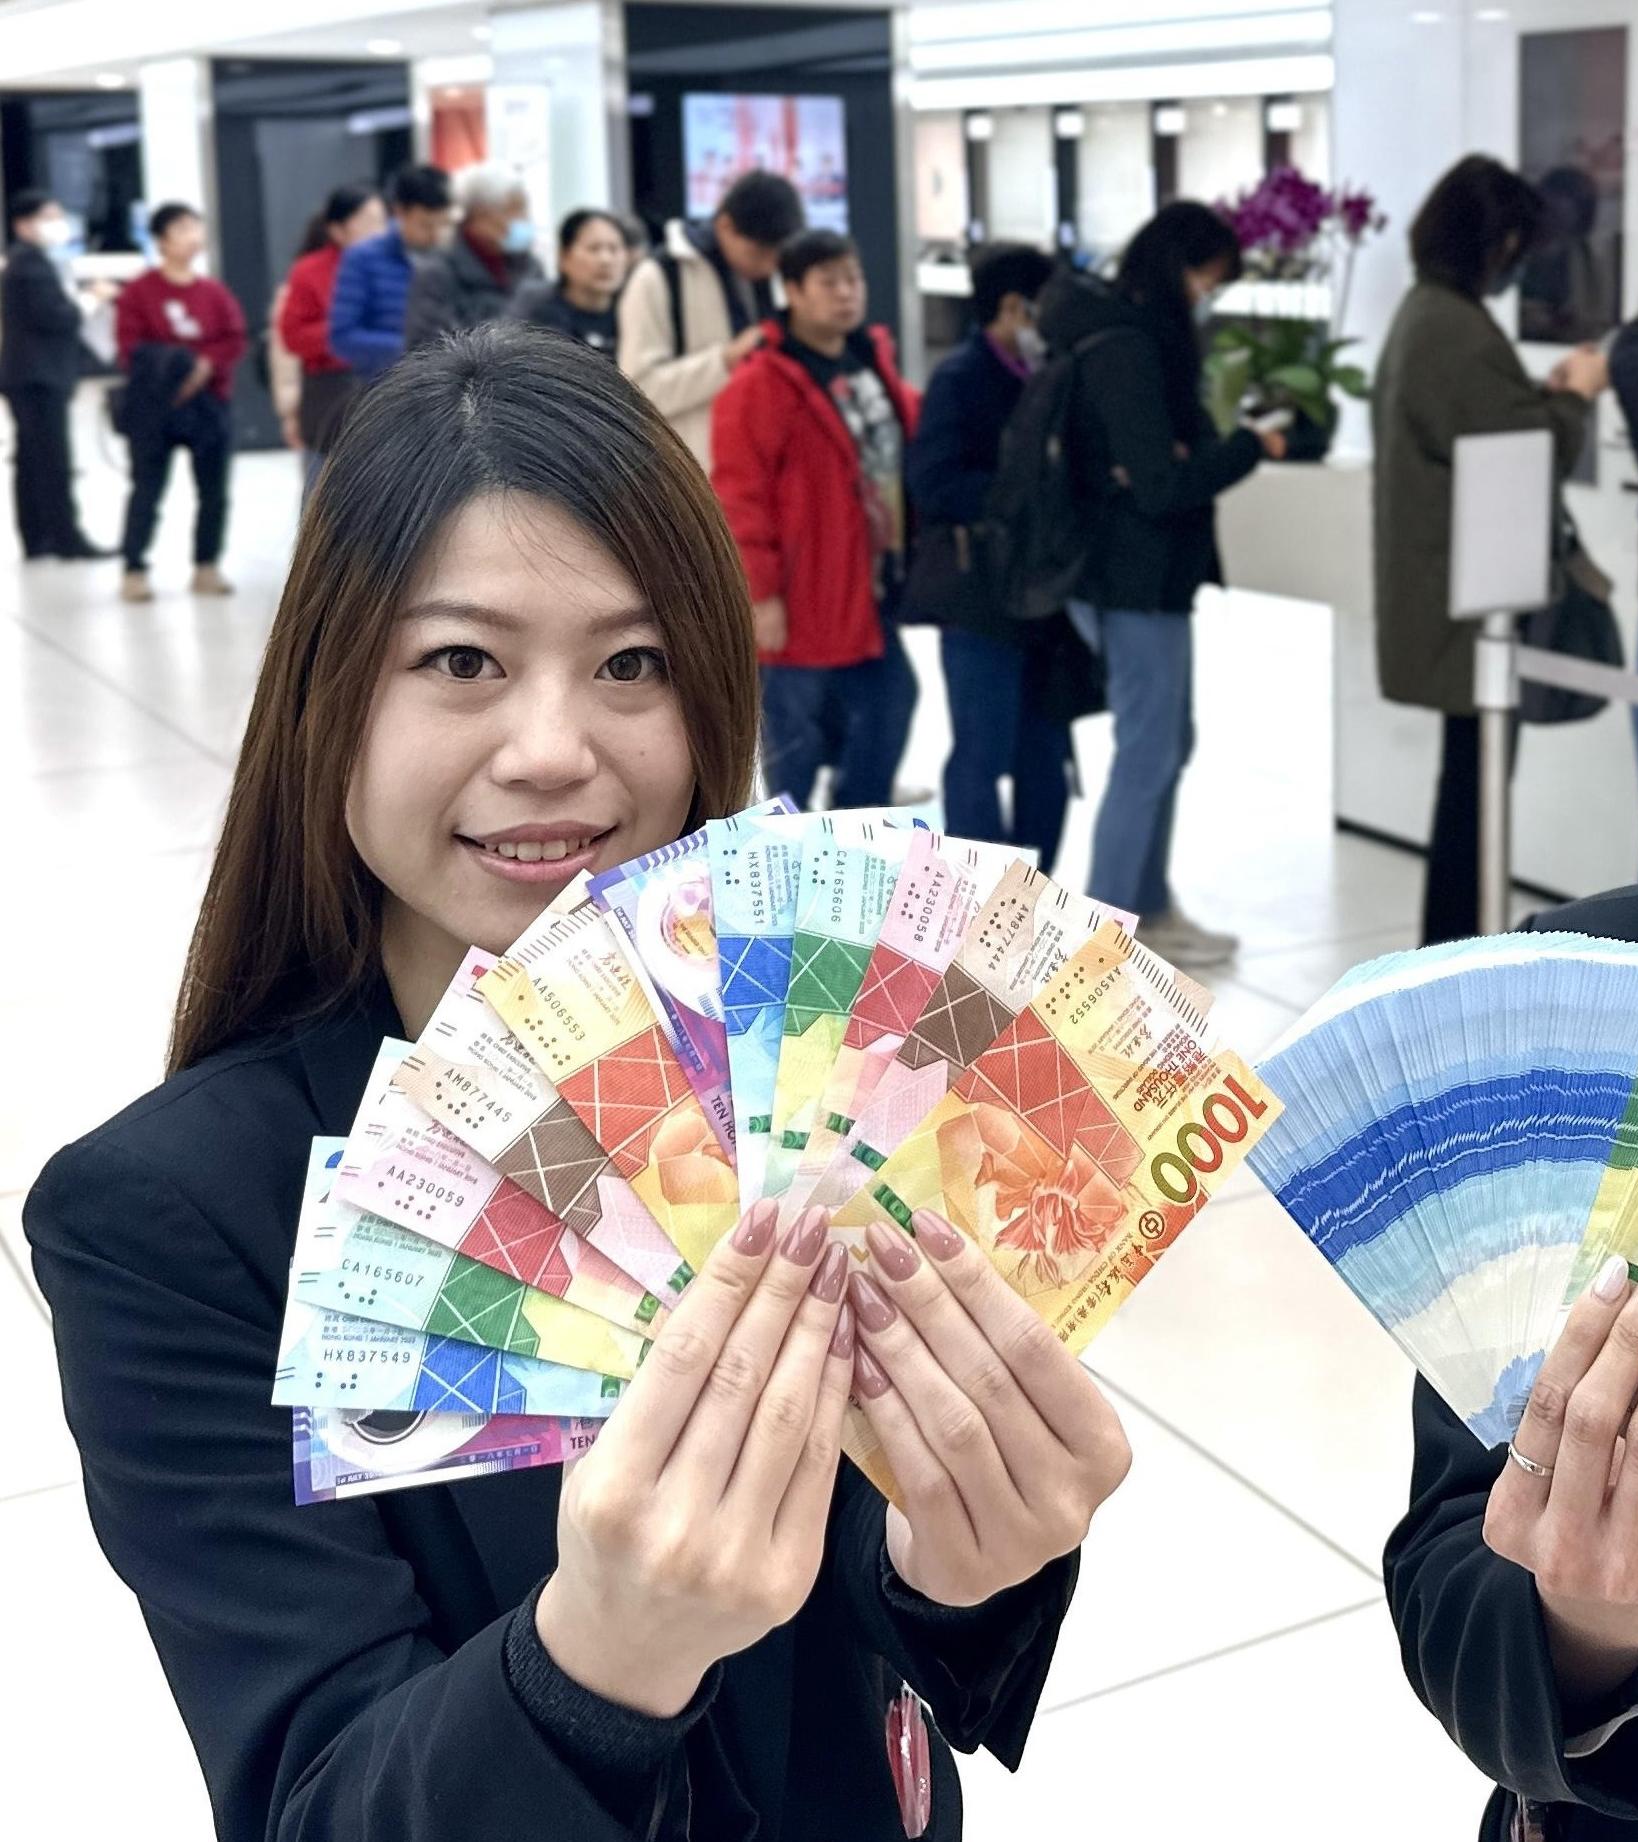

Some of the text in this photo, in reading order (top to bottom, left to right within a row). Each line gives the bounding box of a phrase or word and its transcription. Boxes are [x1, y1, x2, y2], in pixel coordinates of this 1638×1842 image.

[746, 850, 765, 924] HX837551
[828, 849, 848, 923] CA165606
[912, 870, 945, 943] AA230058
[984, 902, 1032, 971] AM877444
[530, 973, 586, 1044] AA506553
[1067, 964, 1123, 1026] AA506552
[1156, 1050, 1175, 1070] KONG
[1171, 1032, 1191, 1053] HONG
[1174, 1037, 1198, 1062] ONE
[443, 1065, 513, 1124] AM877445
[1130, 1058, 1179, 1113] THOUSAND
[1134, 1068, 1159, 1095] DOLLARS
[711, 1094, 736, 1149] TEN HO
[1151, 1074, 1268, 1204] 1000
[385, 1162, 465, 1209] AA230059
[340, 1254, 424, 1290] CA165607
[323, 1345, 411, 1366] HX837549
[570, 1435, 595, 1449] TEN
